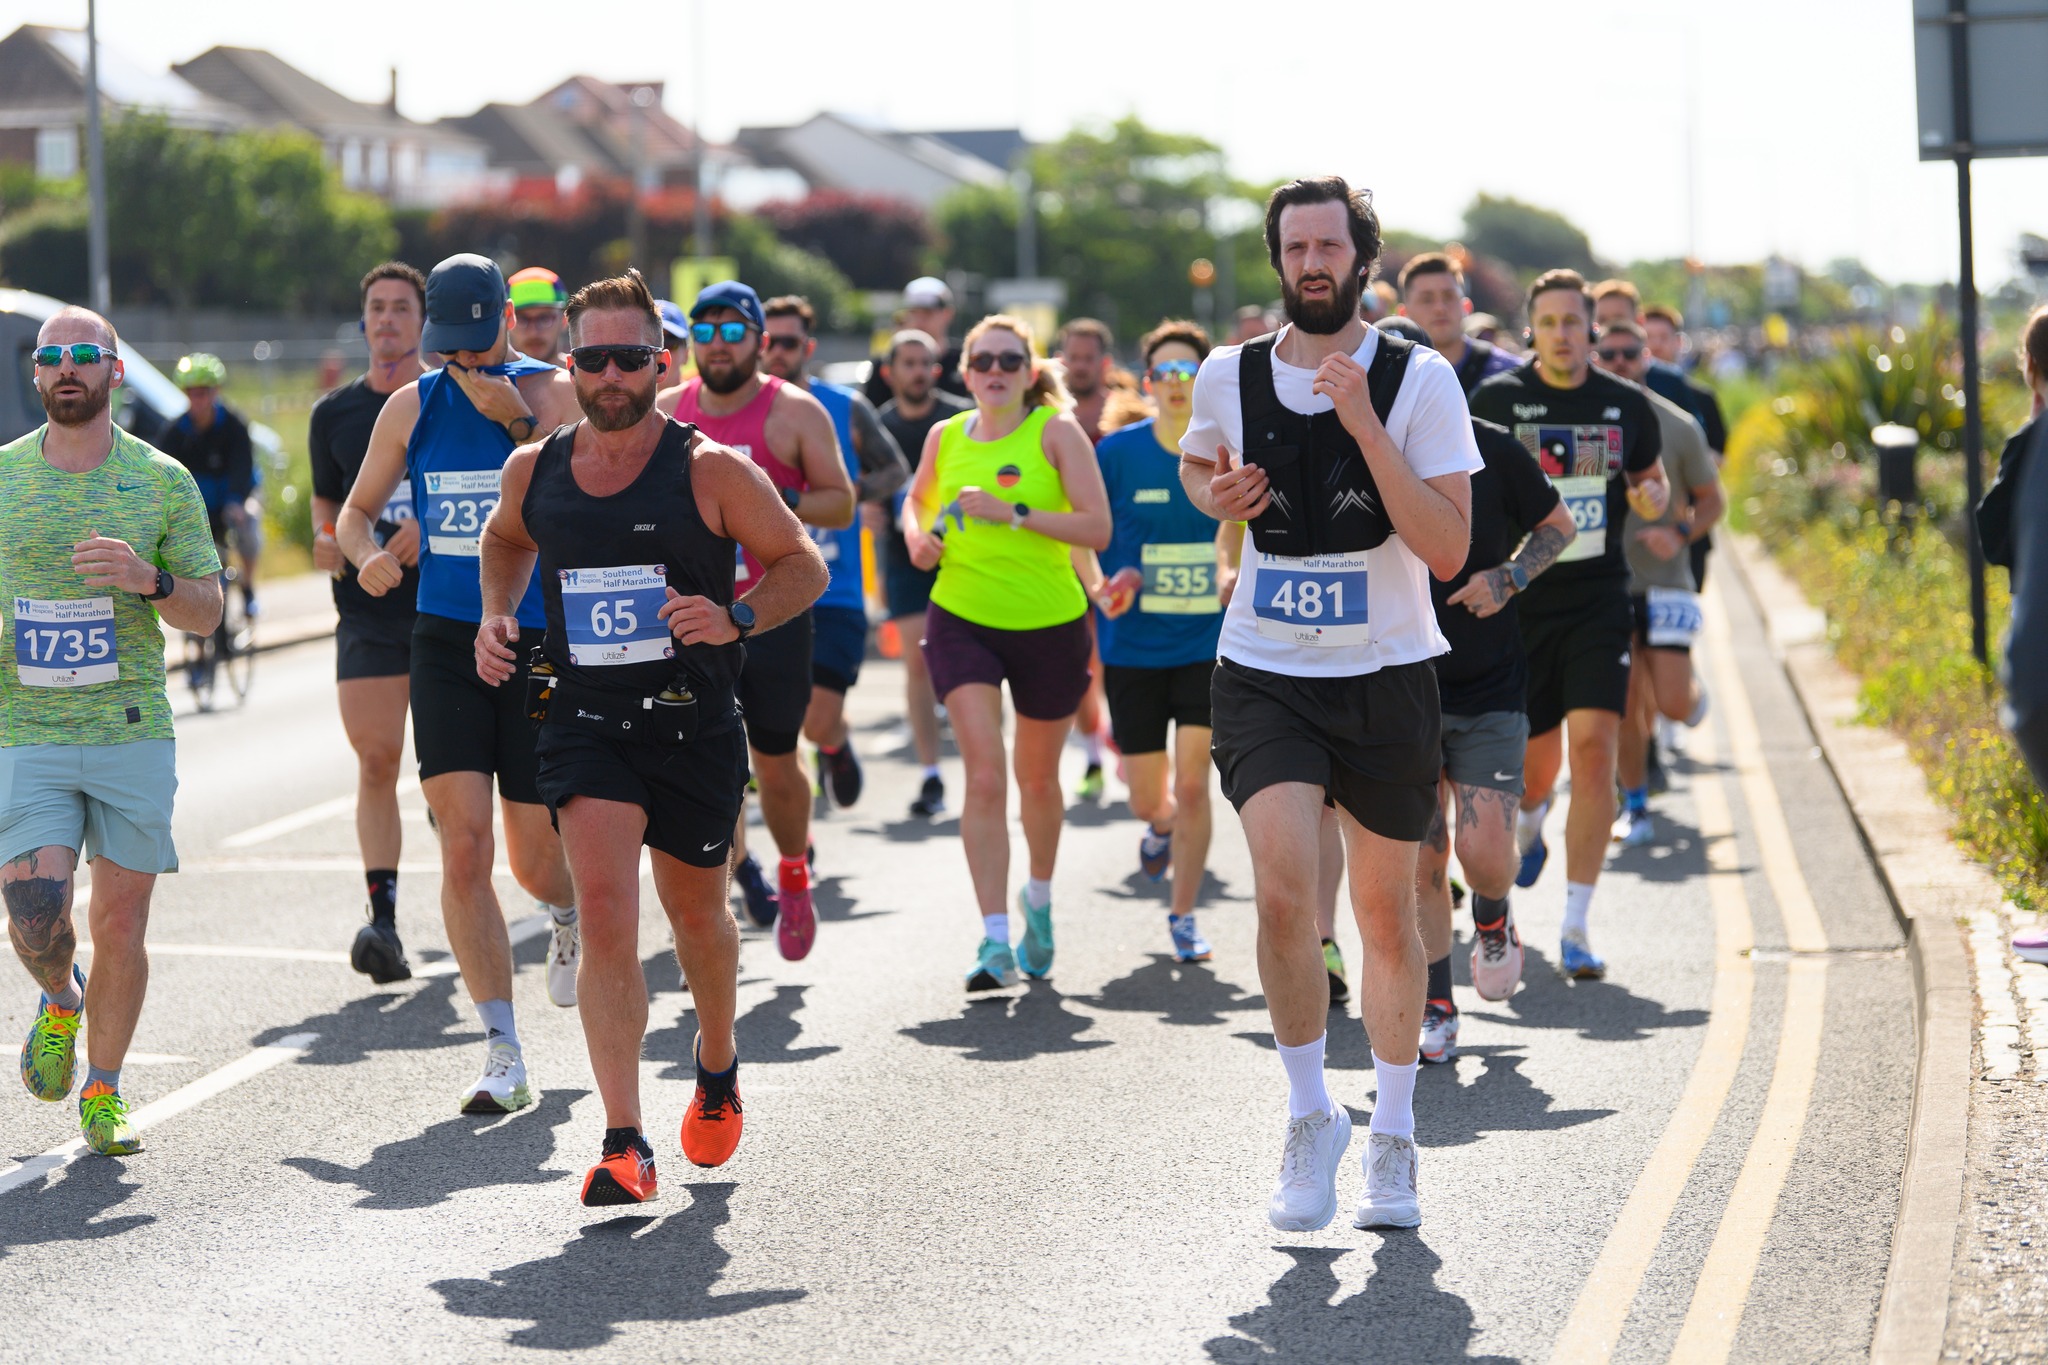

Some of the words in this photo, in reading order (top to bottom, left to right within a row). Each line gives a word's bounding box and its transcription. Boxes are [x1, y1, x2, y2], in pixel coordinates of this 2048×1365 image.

[461, 473, 496, 481] Southend
[461, 482, 476, 490] Half
[1303, 560, 1320, 568] Half
[1322, 560, 1365, 568] Marathon
[602, 568, 643, 579] Southend
[603, 579, 621, 588] Half
[622, 577, 664, 587] Marathon
[1155, 566, 1209, 595] 535
[1271, 579, 1344, 618] 481
[54, 601, 93, 610] Southend
[55, 610, 72, 619] Half
[73, 608, 111, 618] Marathon
[590, 599, 638, 637] 65
[1294, 632, 1319, 641] Utilize
[23, 627, 110, 662] 1735
[601, 652, 626, 660] Utilize
